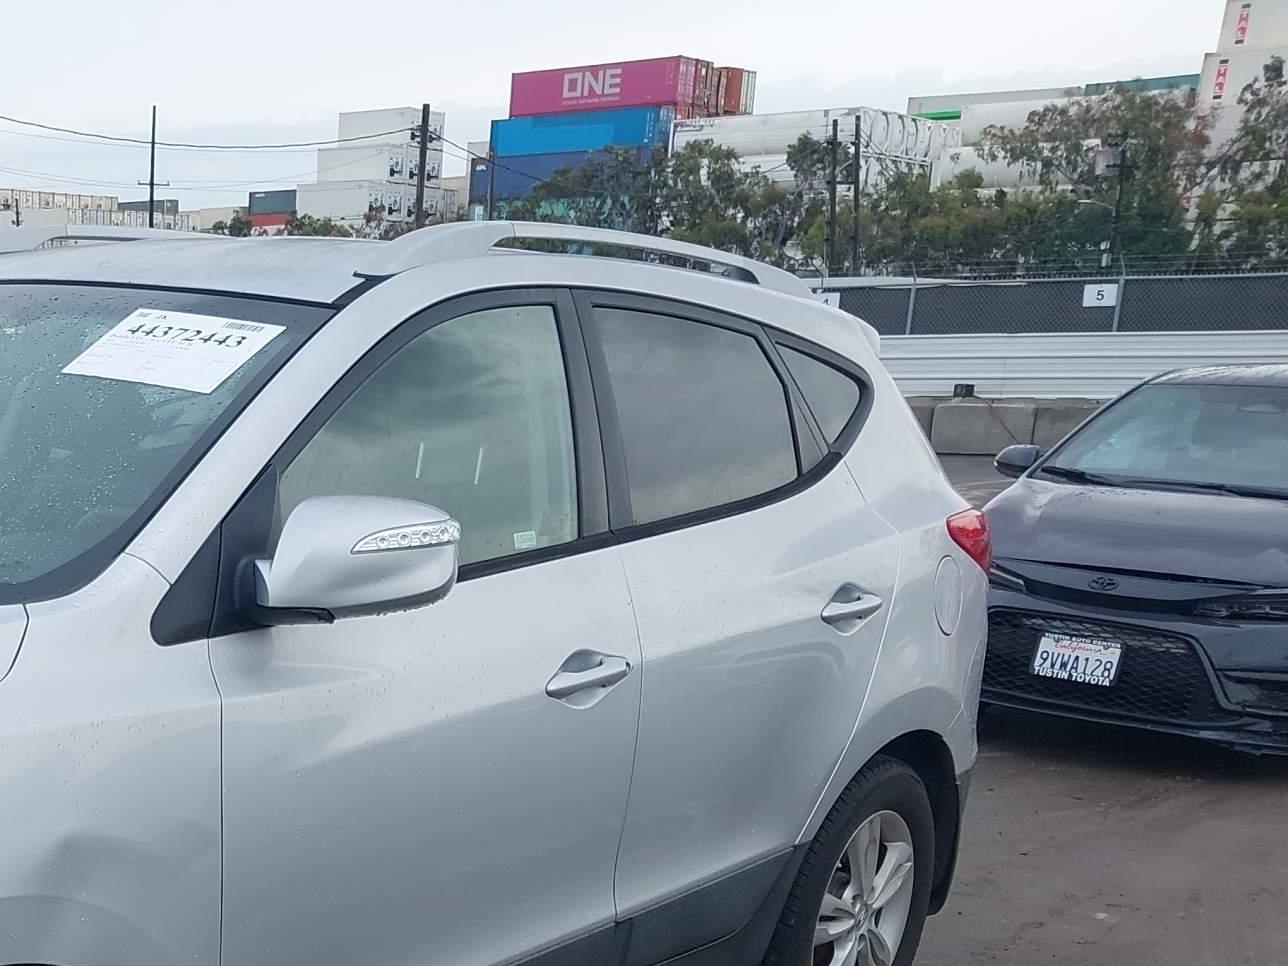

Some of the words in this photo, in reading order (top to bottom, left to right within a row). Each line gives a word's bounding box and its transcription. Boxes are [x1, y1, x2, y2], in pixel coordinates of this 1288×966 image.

[563, 68, 622, 98] ONE
[1096, 290, 1105, 301] 5
[127, 323, 248, 348] 44372443
[1044, 632, 1071, 641] TUSTIN
[1072, 636, 1091, 645] AUTO
[1092, 640, 1121, 649] CENTER
[1054, 640, 1107, 656] California
[1038, 650, 1114, 678] 9VWA128
[1033, 666, 1070, 680] TUSTIN
[1071, 672, 1110, 687] TOYOTA
